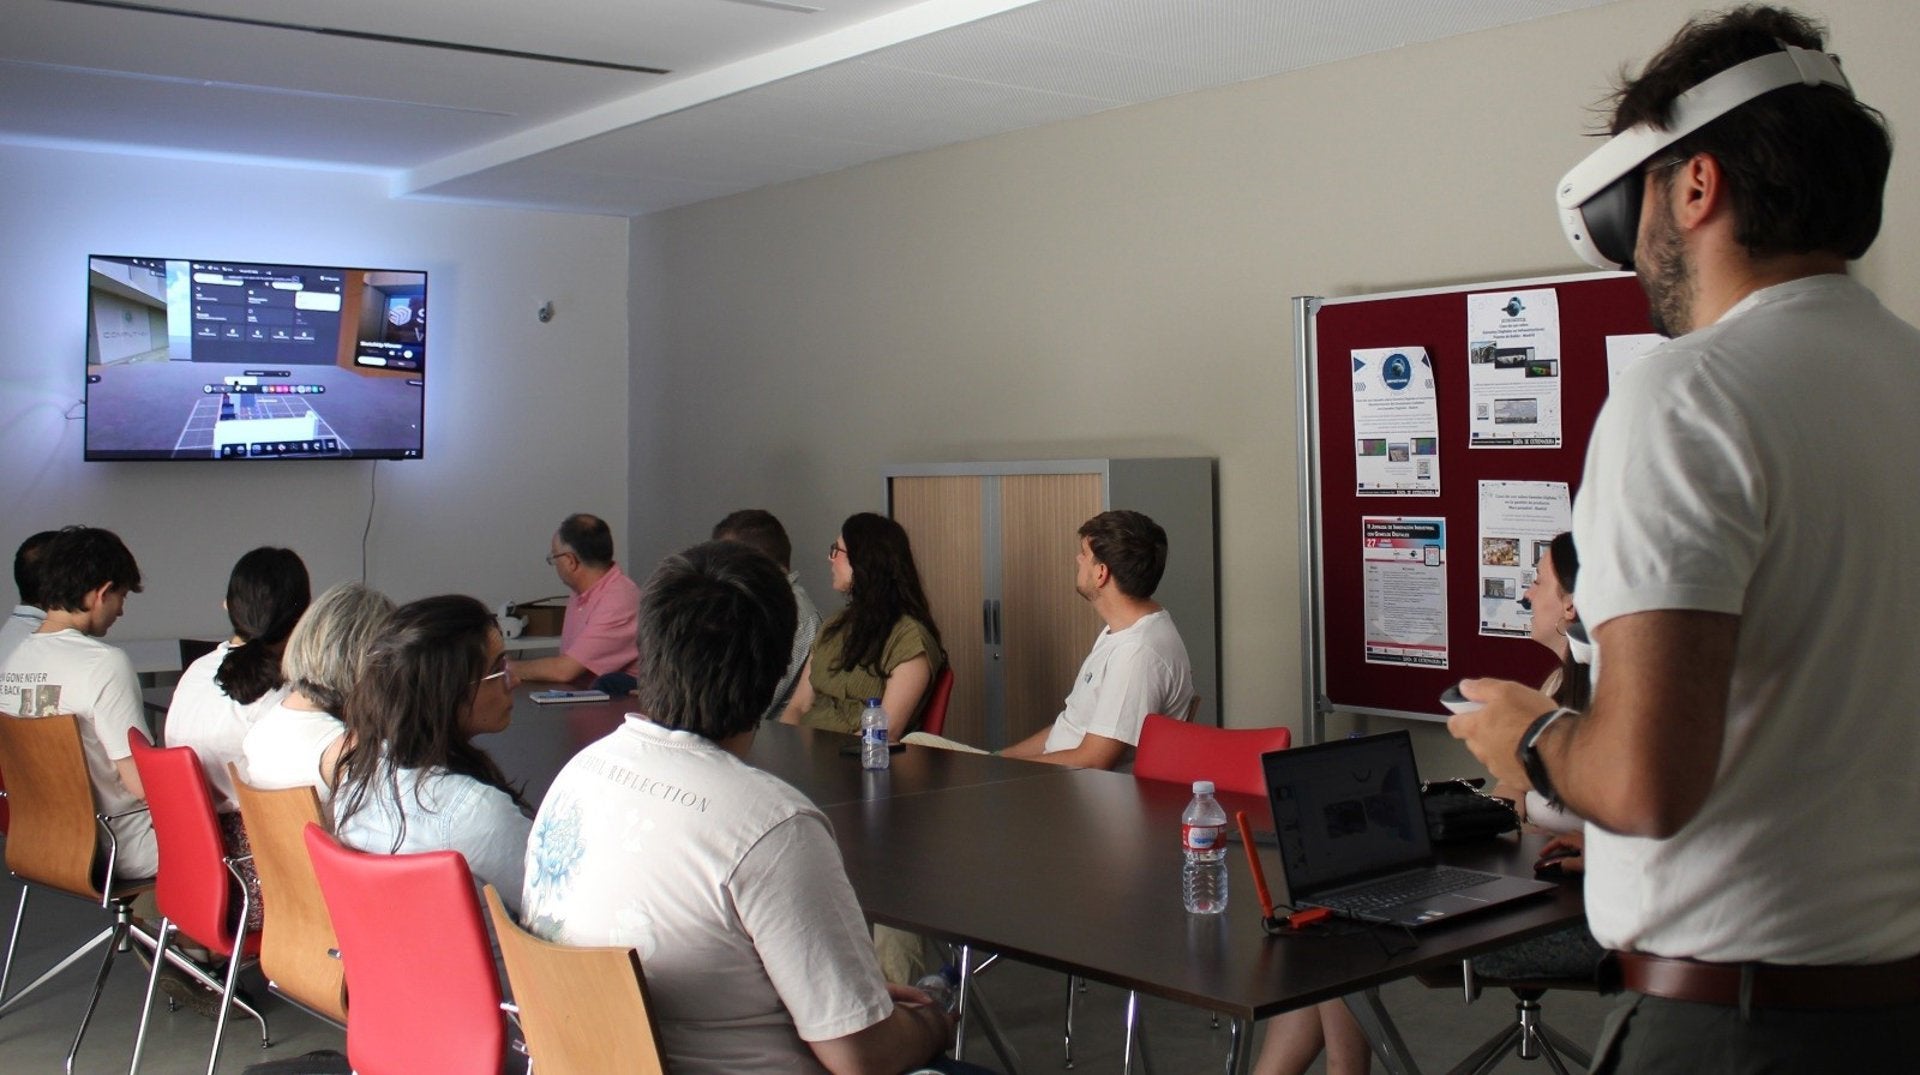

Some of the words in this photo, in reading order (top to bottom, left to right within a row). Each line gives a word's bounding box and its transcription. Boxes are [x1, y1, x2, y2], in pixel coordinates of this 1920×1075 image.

[6, 672, 24, 683] GONE
[24, 672, 48, 683] NEVER
[4, 685, 20, 696] BACK
[607, 764, 712, 813] REFLECTION
